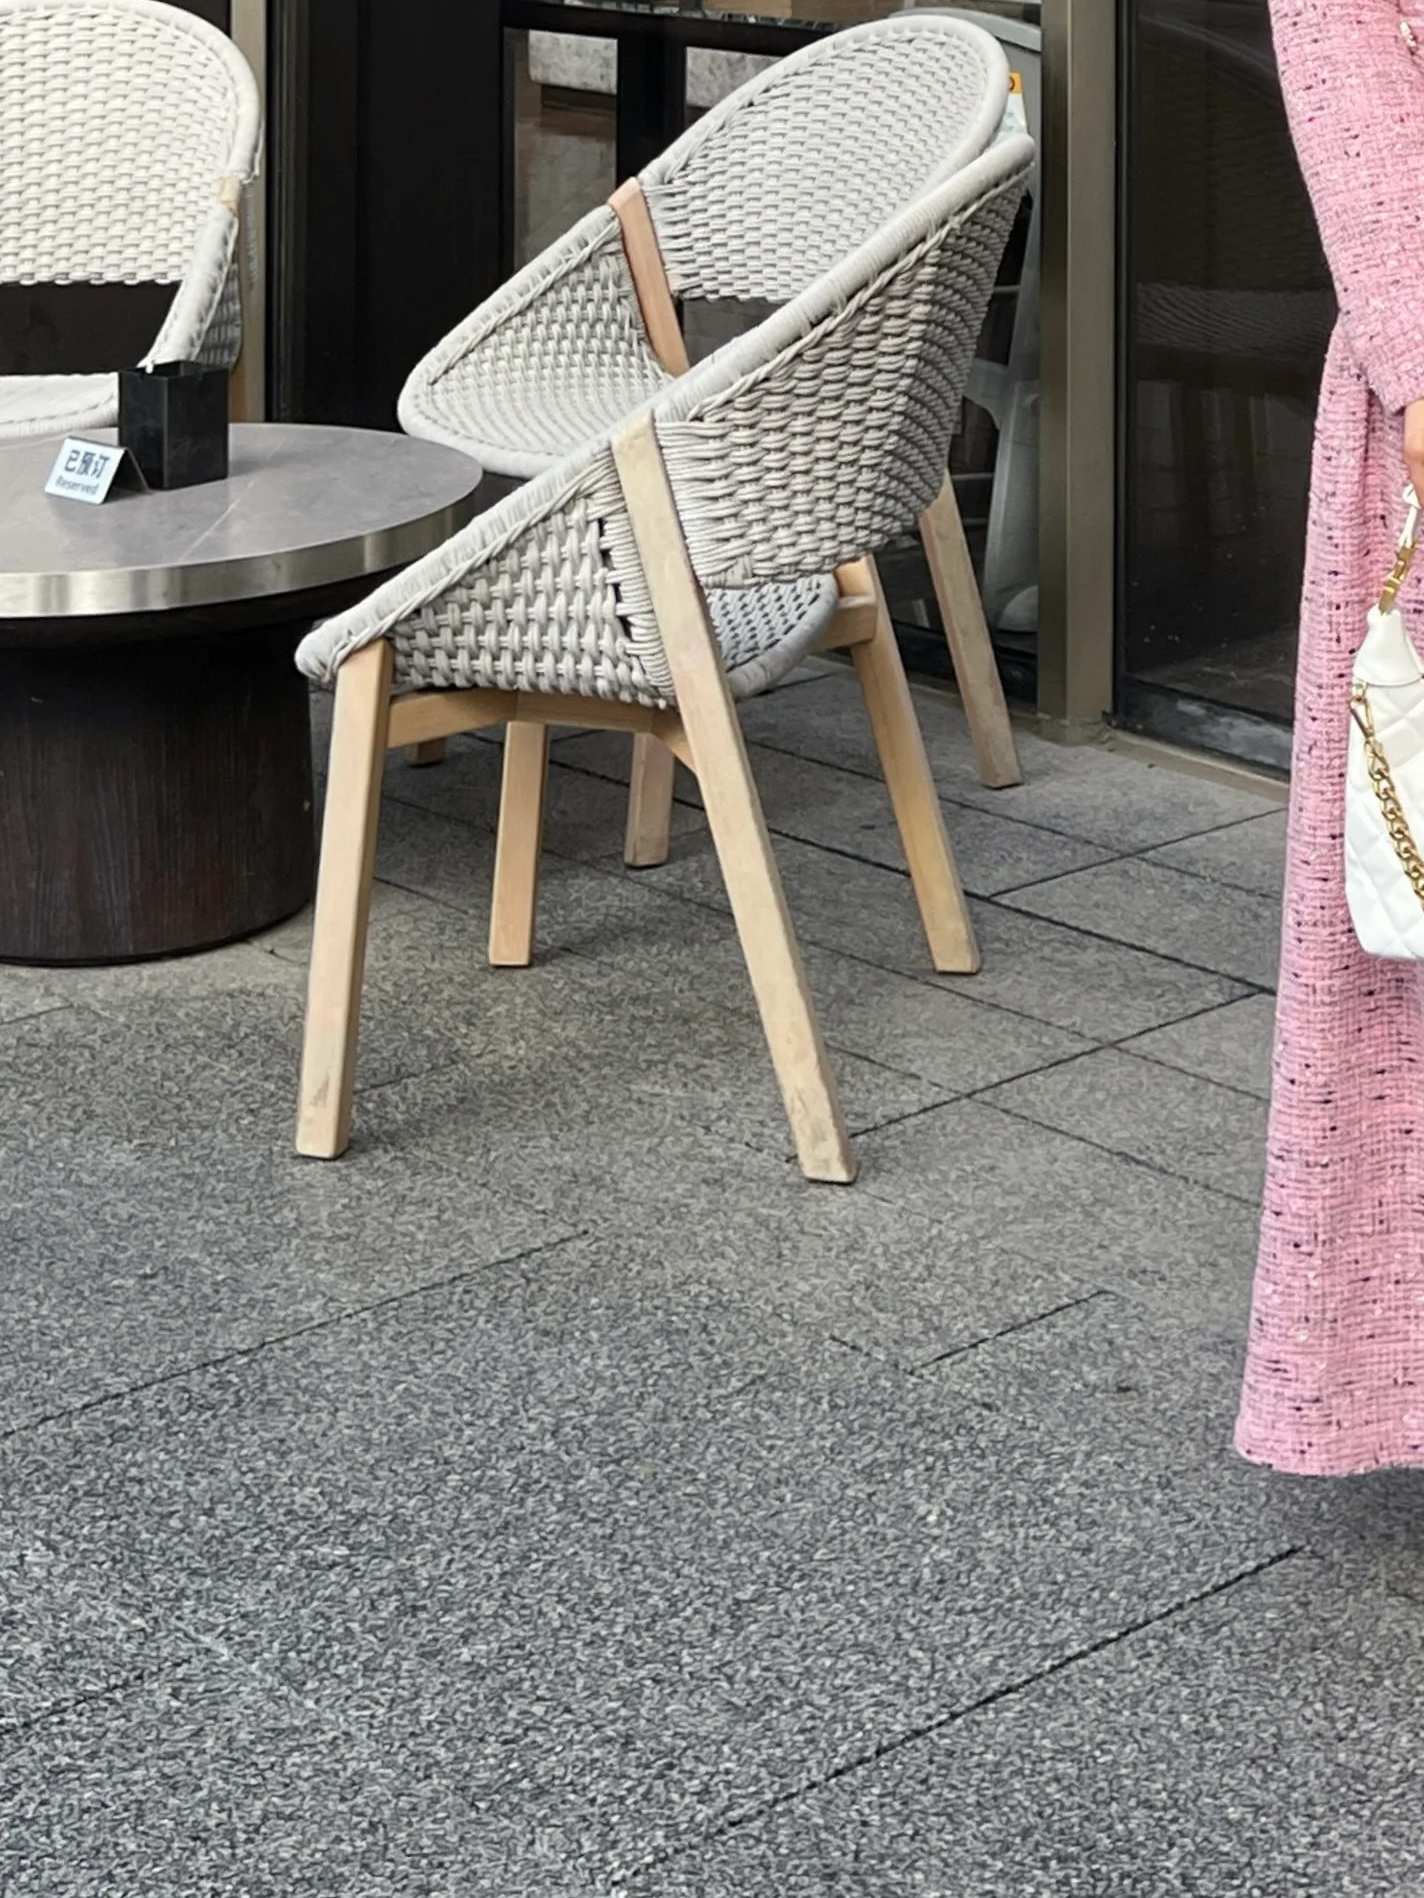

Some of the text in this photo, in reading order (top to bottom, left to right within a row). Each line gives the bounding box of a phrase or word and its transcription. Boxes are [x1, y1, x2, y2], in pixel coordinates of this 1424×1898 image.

[64, 449, 111, 479] 已预订
[55, 474, 99, 496] Reserved
